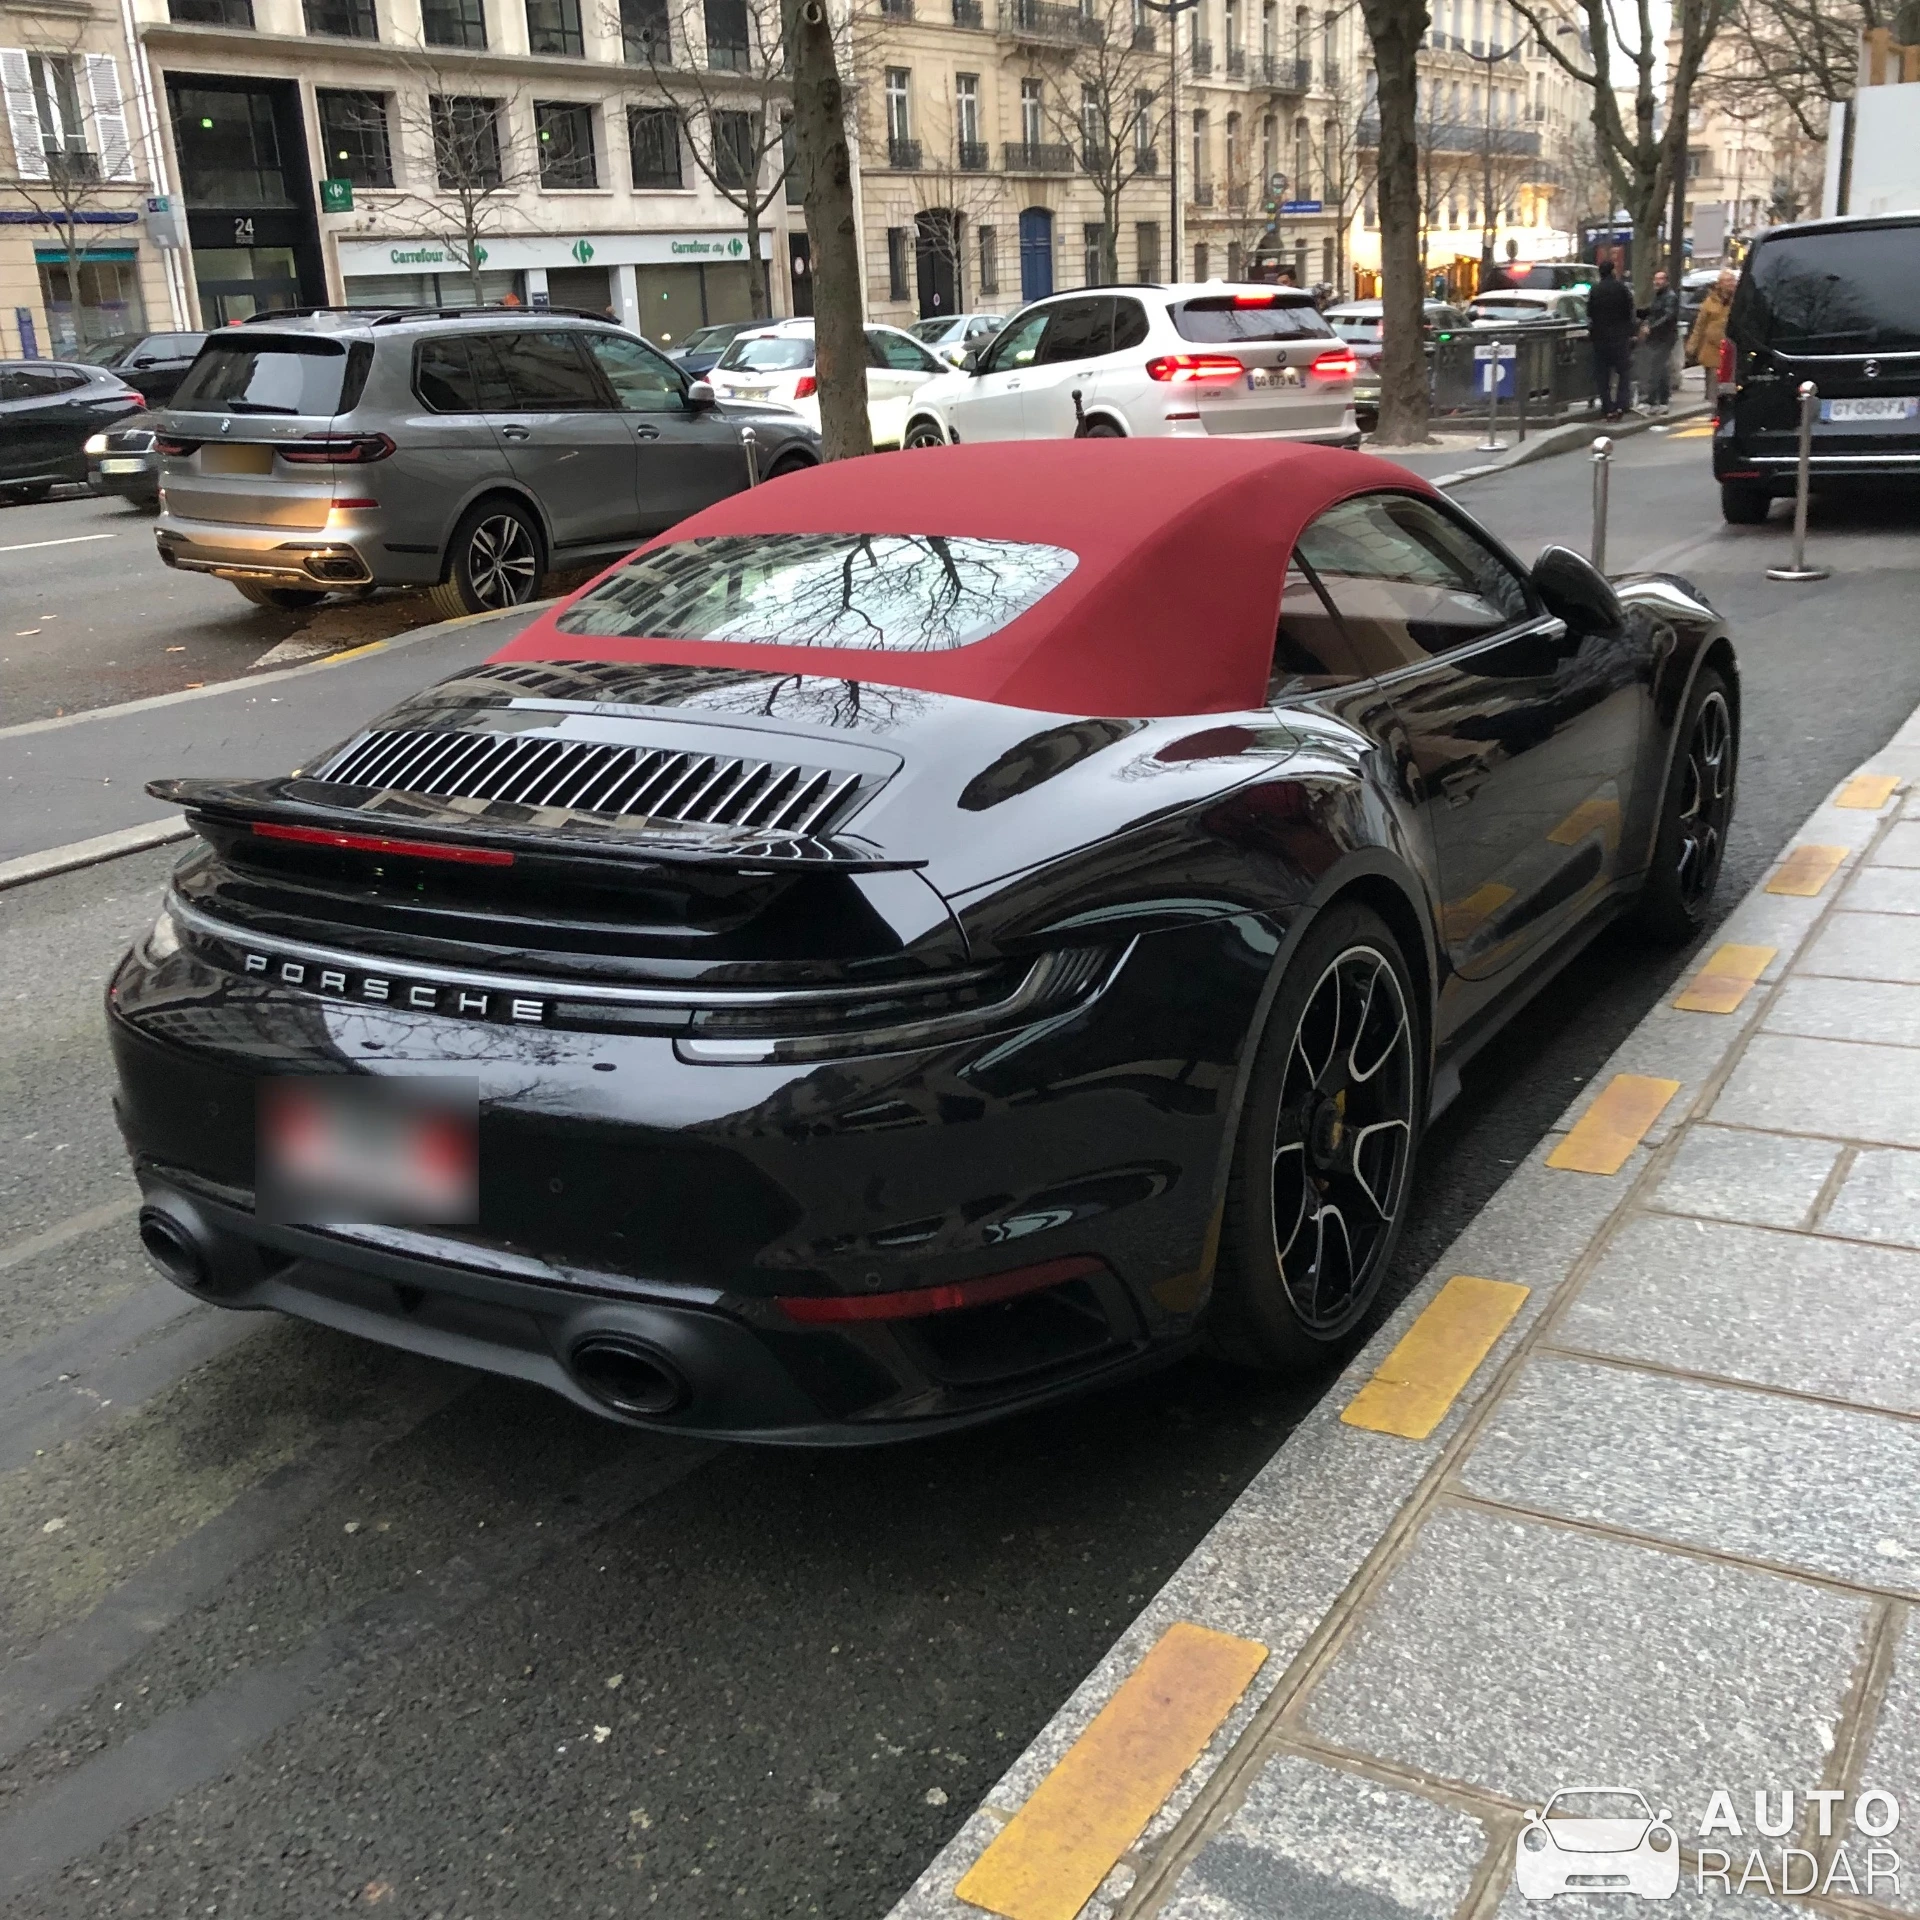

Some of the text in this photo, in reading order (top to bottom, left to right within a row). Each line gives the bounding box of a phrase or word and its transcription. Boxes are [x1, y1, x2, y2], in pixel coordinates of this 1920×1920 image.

[235, 218, 254, 235] 24
[671, 240, 710, 254] Carrefour
[391, 248, 443, 264] Carrefour
[1483, 363, 1506, 392] P
[245, 953, 543, 1022] PORSCHE
